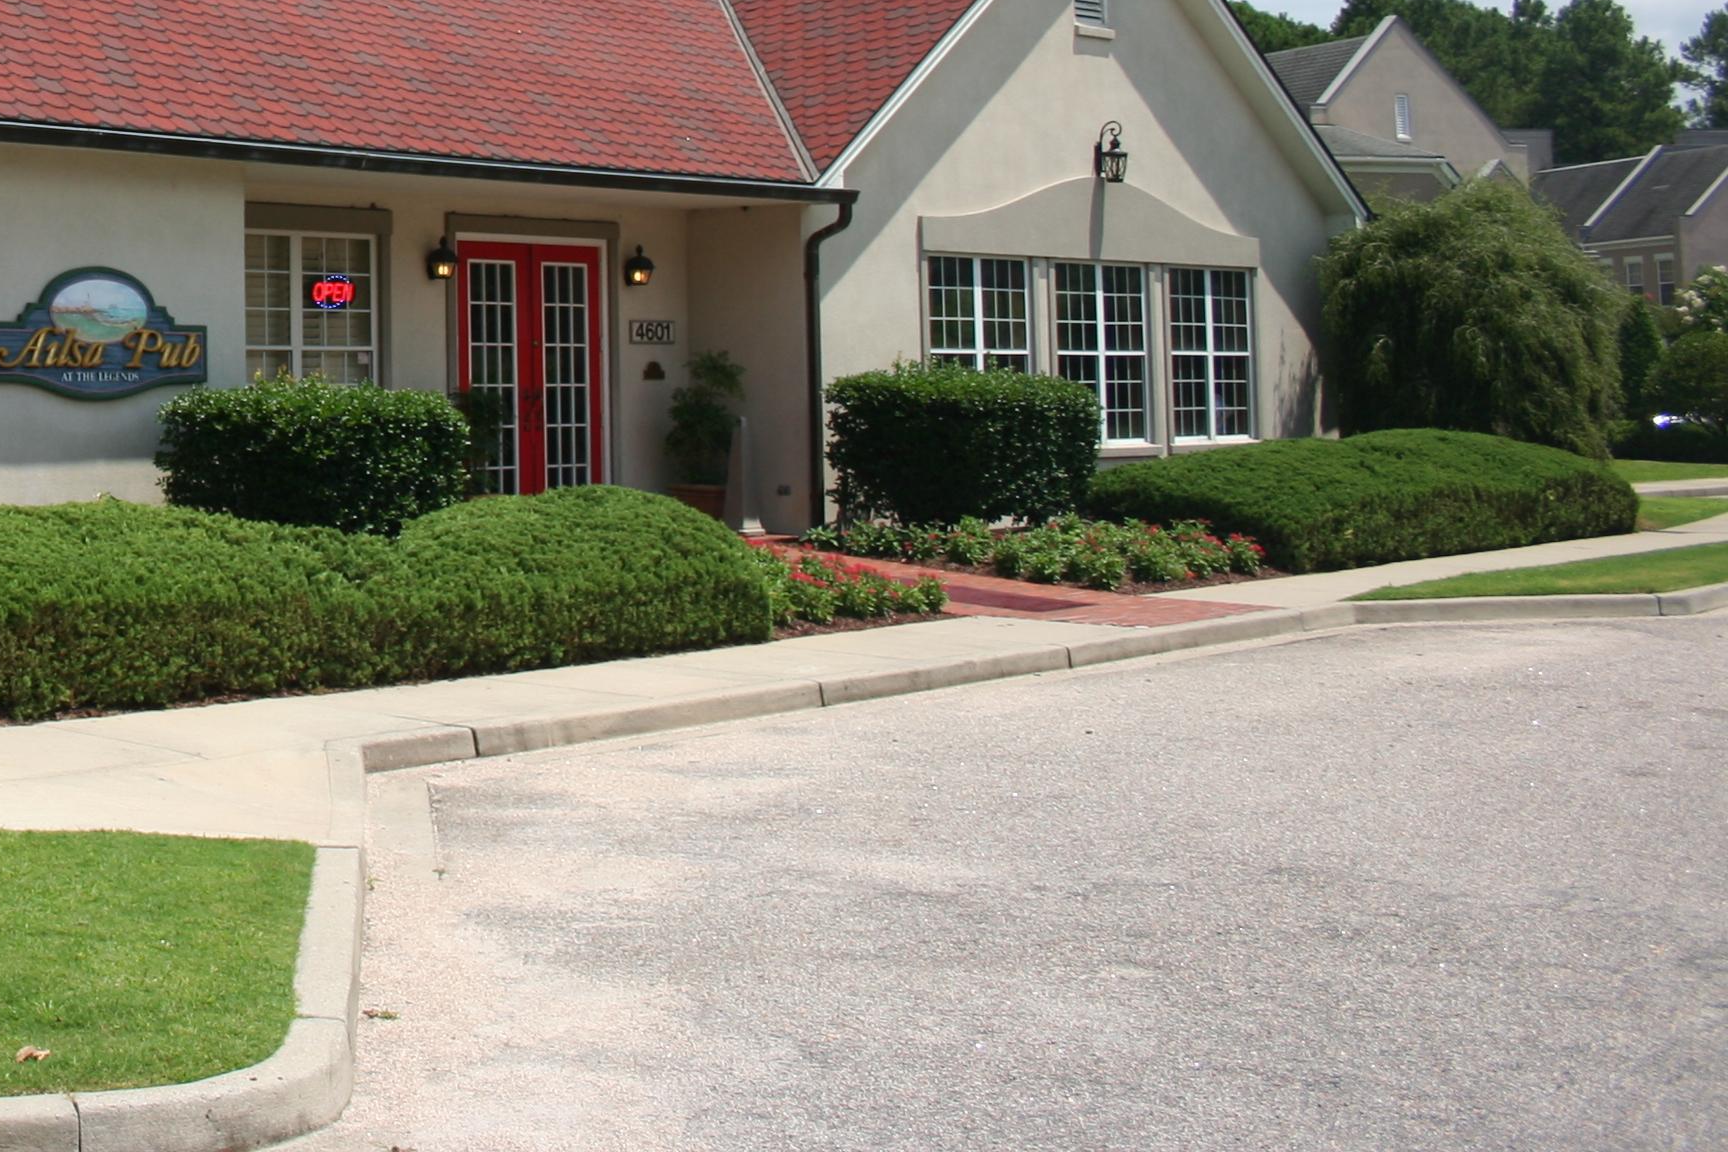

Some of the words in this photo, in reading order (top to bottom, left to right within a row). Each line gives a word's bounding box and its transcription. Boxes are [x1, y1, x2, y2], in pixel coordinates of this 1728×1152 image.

[312, 281, 354, 303] OPEN
[634, 322, 671, 341] 4601
[123, 326, 201, 369] Pub
[61, 371, 73, 382] AT
[76, 371, 96, 382] THE
[98, 371, 140, 382] LEGENDS
